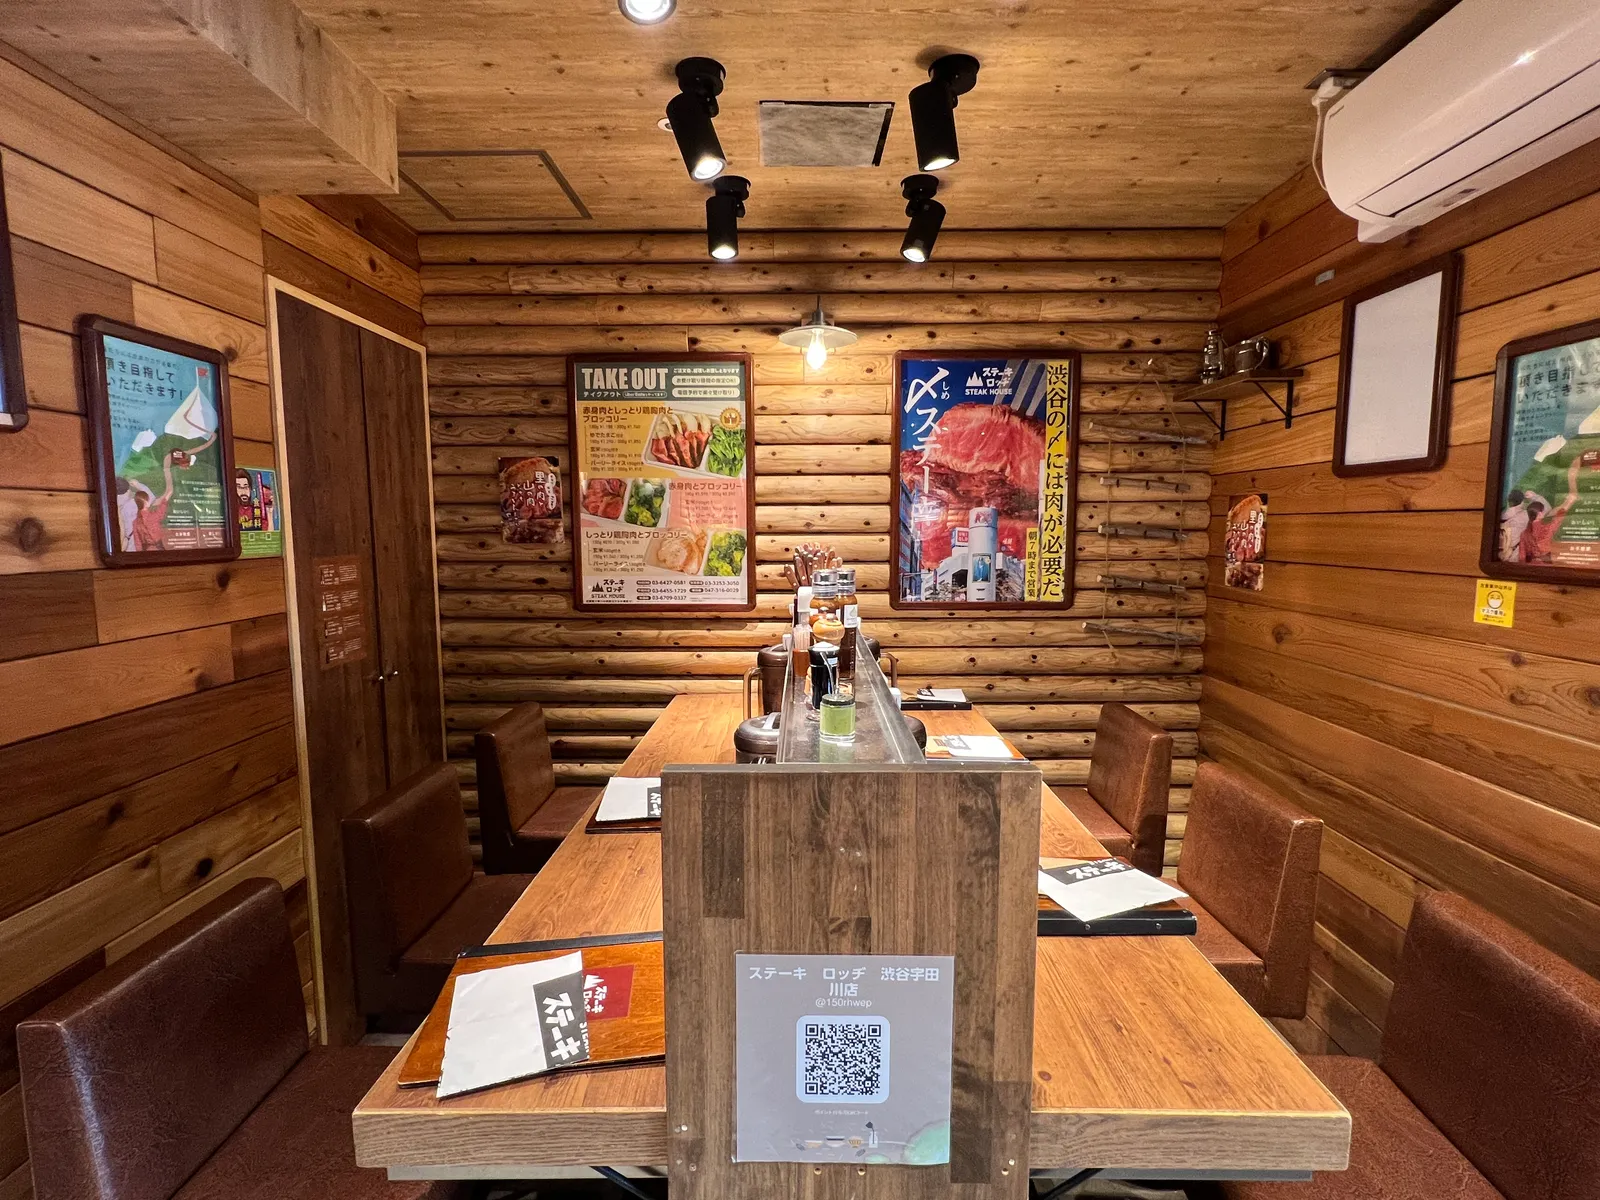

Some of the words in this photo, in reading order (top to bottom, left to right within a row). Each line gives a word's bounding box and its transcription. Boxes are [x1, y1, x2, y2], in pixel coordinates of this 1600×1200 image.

[982, 367, 1014, 377] ステーキ
[581, 368, 629, 389] TAKE
[631, 368, 668, 389] OUT
[986, 377, 1011, 387] ロッヂ
[940, 381, 950, 400] しめ
[965, 388, 988, 396] STEAK
[582, 406, 673, 415] 赤身肉としっとり鶏胸肉と
[583, 415, 628, 423] ブロッコリー
[1043, 364, 1068, 597] 渋谷の〆には肉が必要だ
[668, 482, 742, 491] 赤身肉とブロッコリー
[585, 531, 688, 539] しっとり鶏胸肉とブロッコリー
[1026, 531, 1038, 598] 朝7時まで営業
[603, 578, 625, 586] ステーキ
[749, 966, 807, 980] ステーキ
[823, 966, 866, 981] ロッヂ
[880, 967, 940, 982] 渋谷宇田
[829, 983, 859, 997] 川店
[591, 986, 608, 1013] ステーキ
[815, 998, 872, 1008] @150rhwep
[542, 992, 581, 1061] ステーキ
